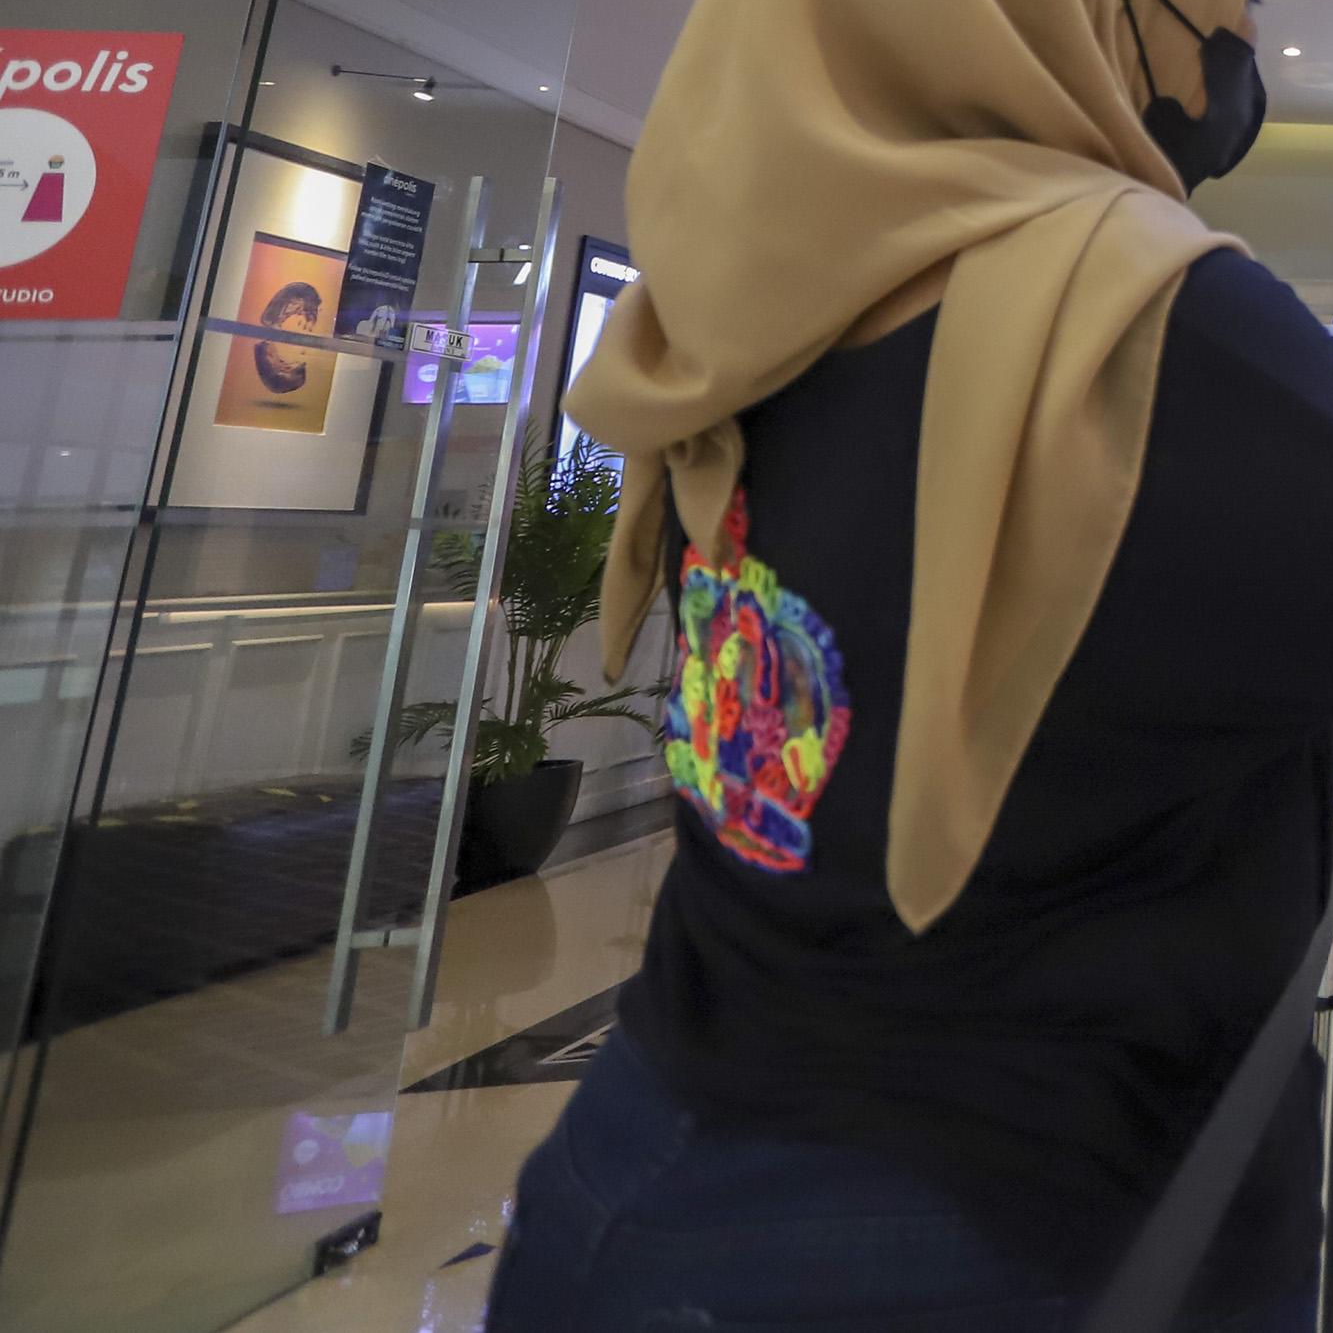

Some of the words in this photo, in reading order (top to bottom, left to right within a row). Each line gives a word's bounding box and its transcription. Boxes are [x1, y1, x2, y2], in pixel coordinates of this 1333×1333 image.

[0, 49, 153, 101] polis
[0, 288, 54, 303] UDIO
[426, 330, 463, 347] MASUK
